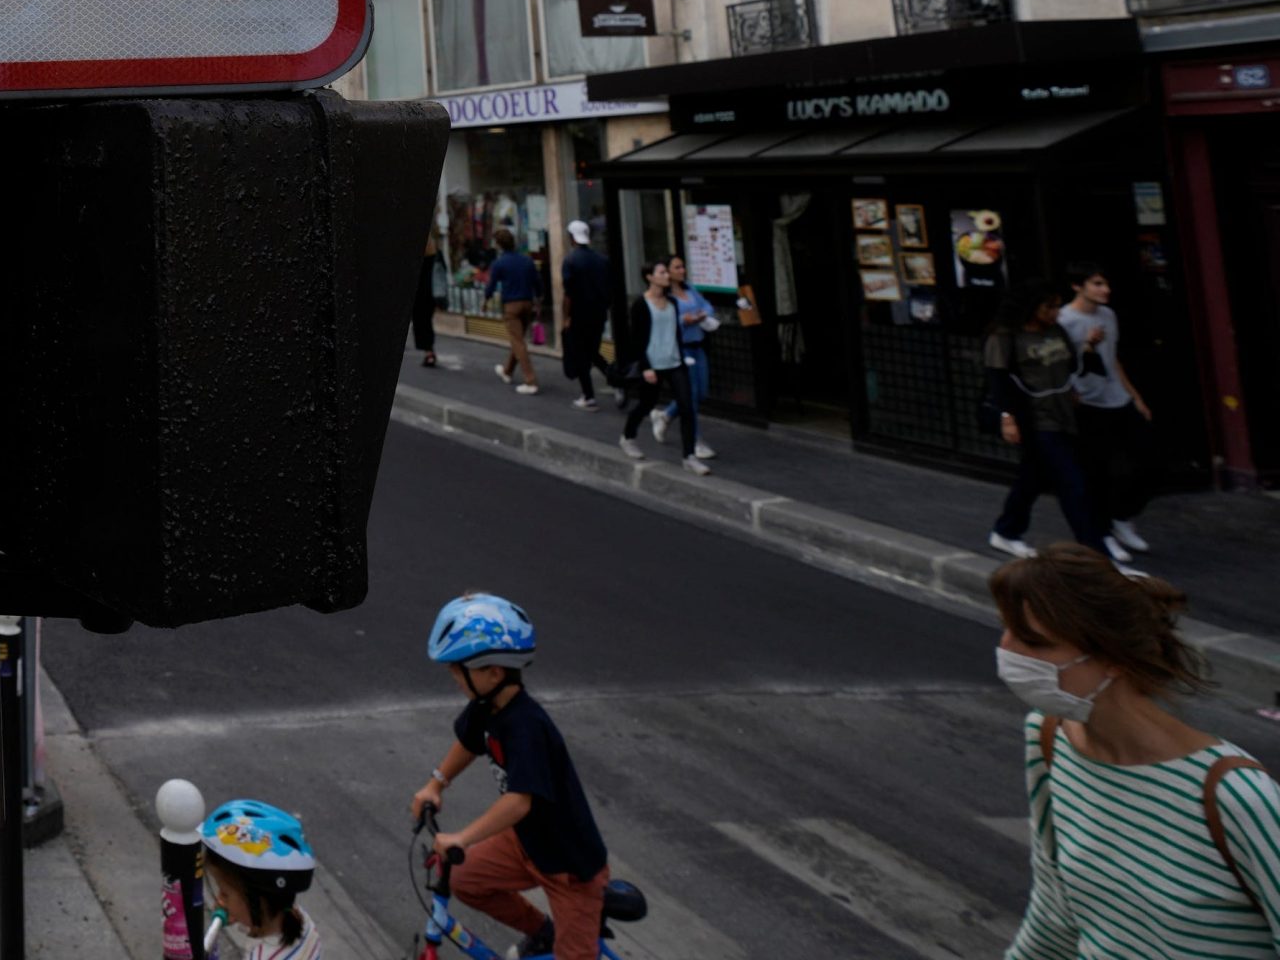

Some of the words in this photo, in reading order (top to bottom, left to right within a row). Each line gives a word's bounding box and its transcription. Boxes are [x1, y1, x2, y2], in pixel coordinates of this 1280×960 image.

[448, 88, 560, 124] DOCOEUR
[787, 96, 853, 120] LUCY'S
[856, 88, 950, 116] KAMADO
